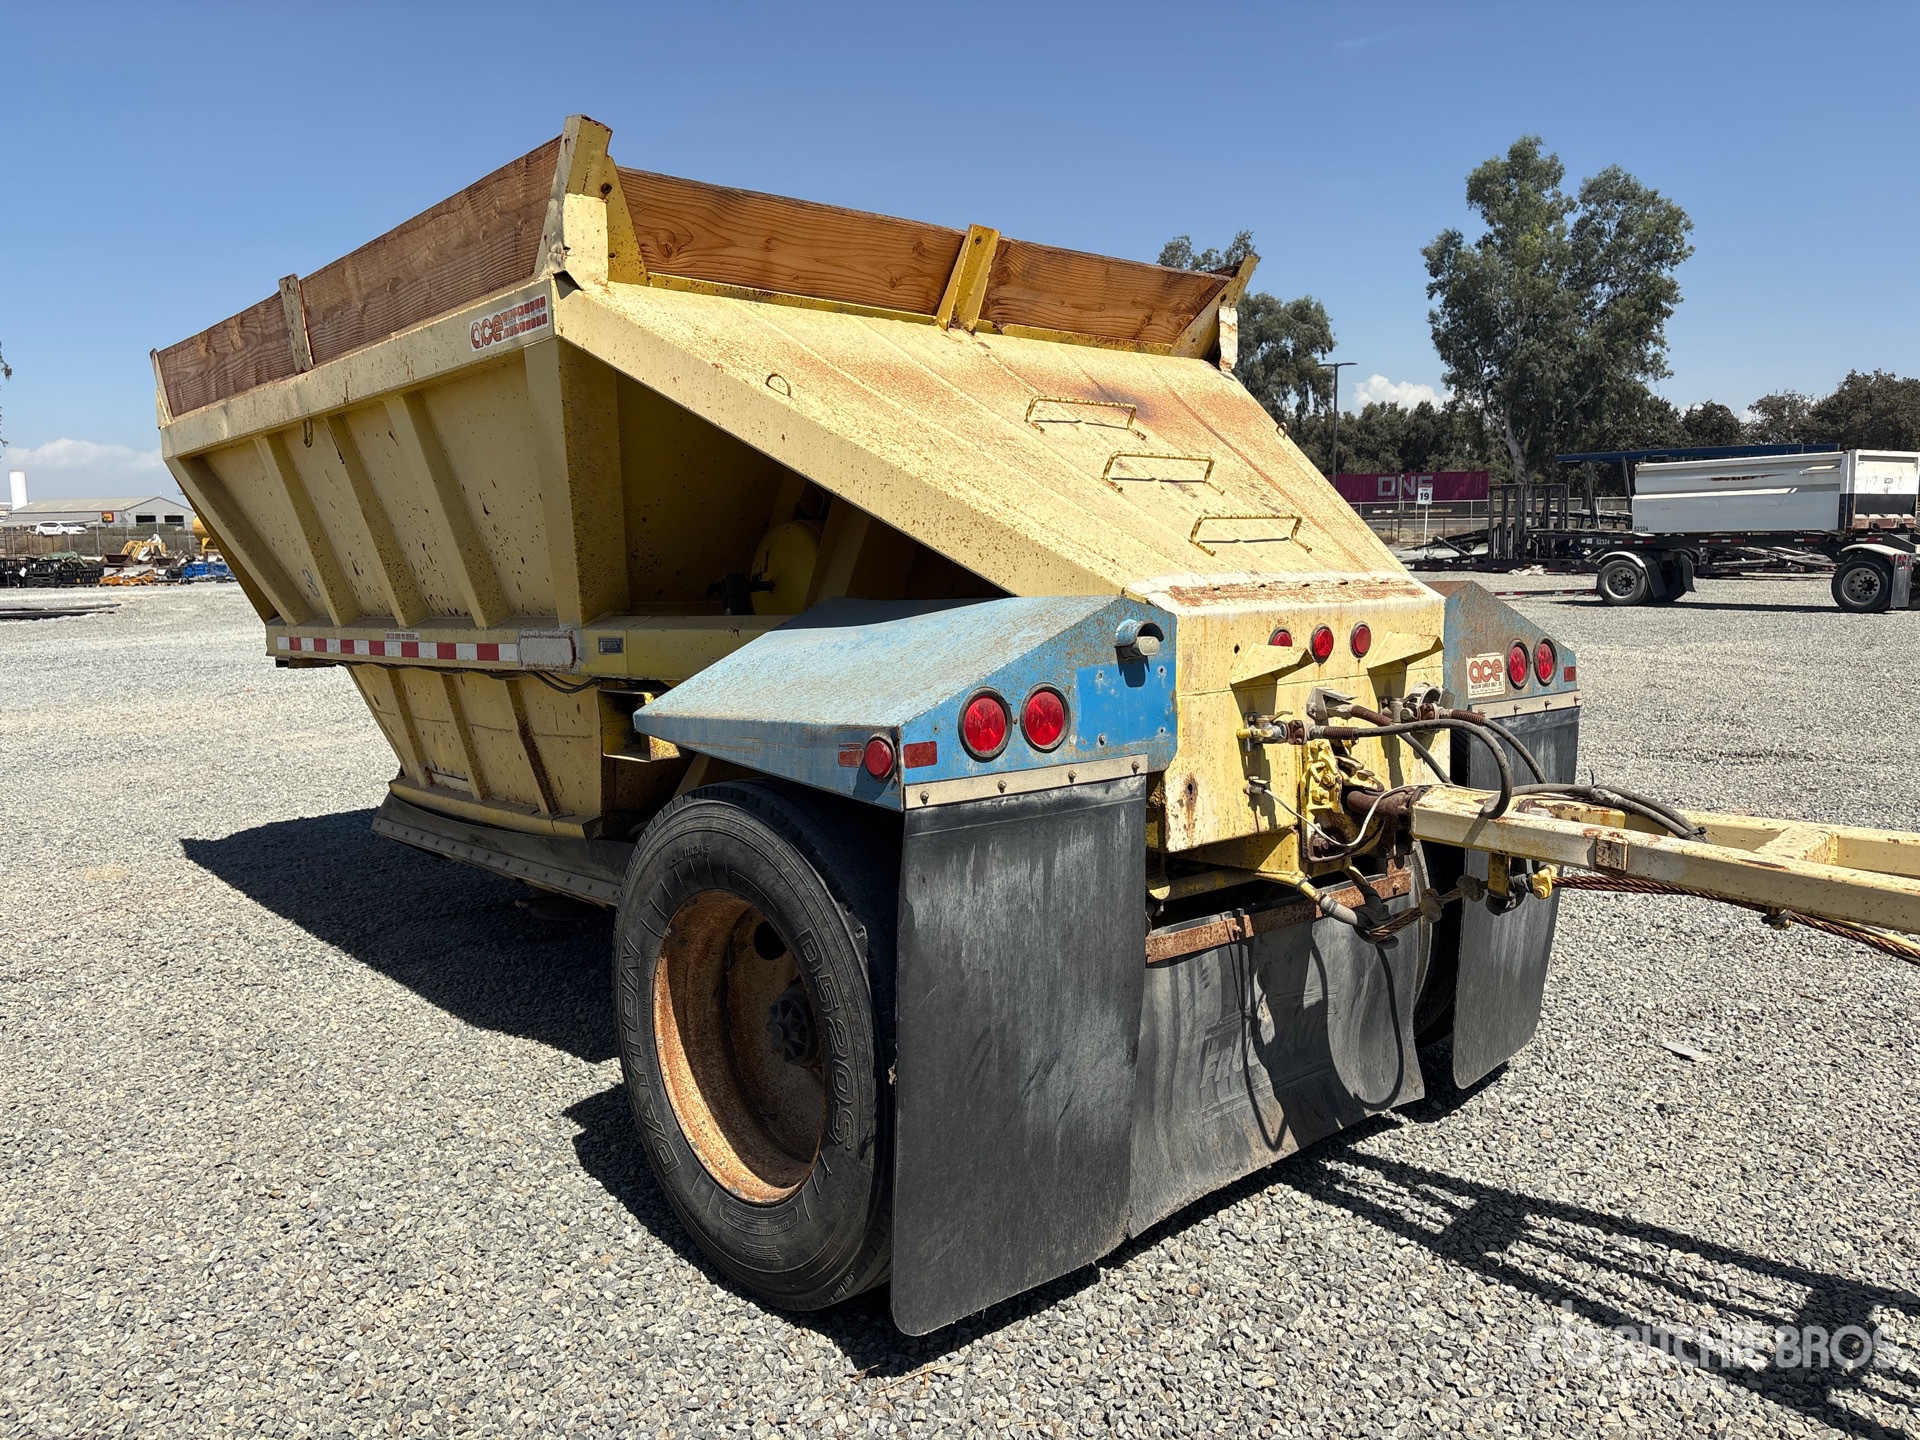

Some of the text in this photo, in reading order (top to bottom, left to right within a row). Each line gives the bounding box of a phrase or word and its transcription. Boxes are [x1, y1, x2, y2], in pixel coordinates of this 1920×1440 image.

[1419, 491, 1430, 501] 19
[1469, 658, 1502, 684] ace
[620, 934, 682, 1175] DAYTON
